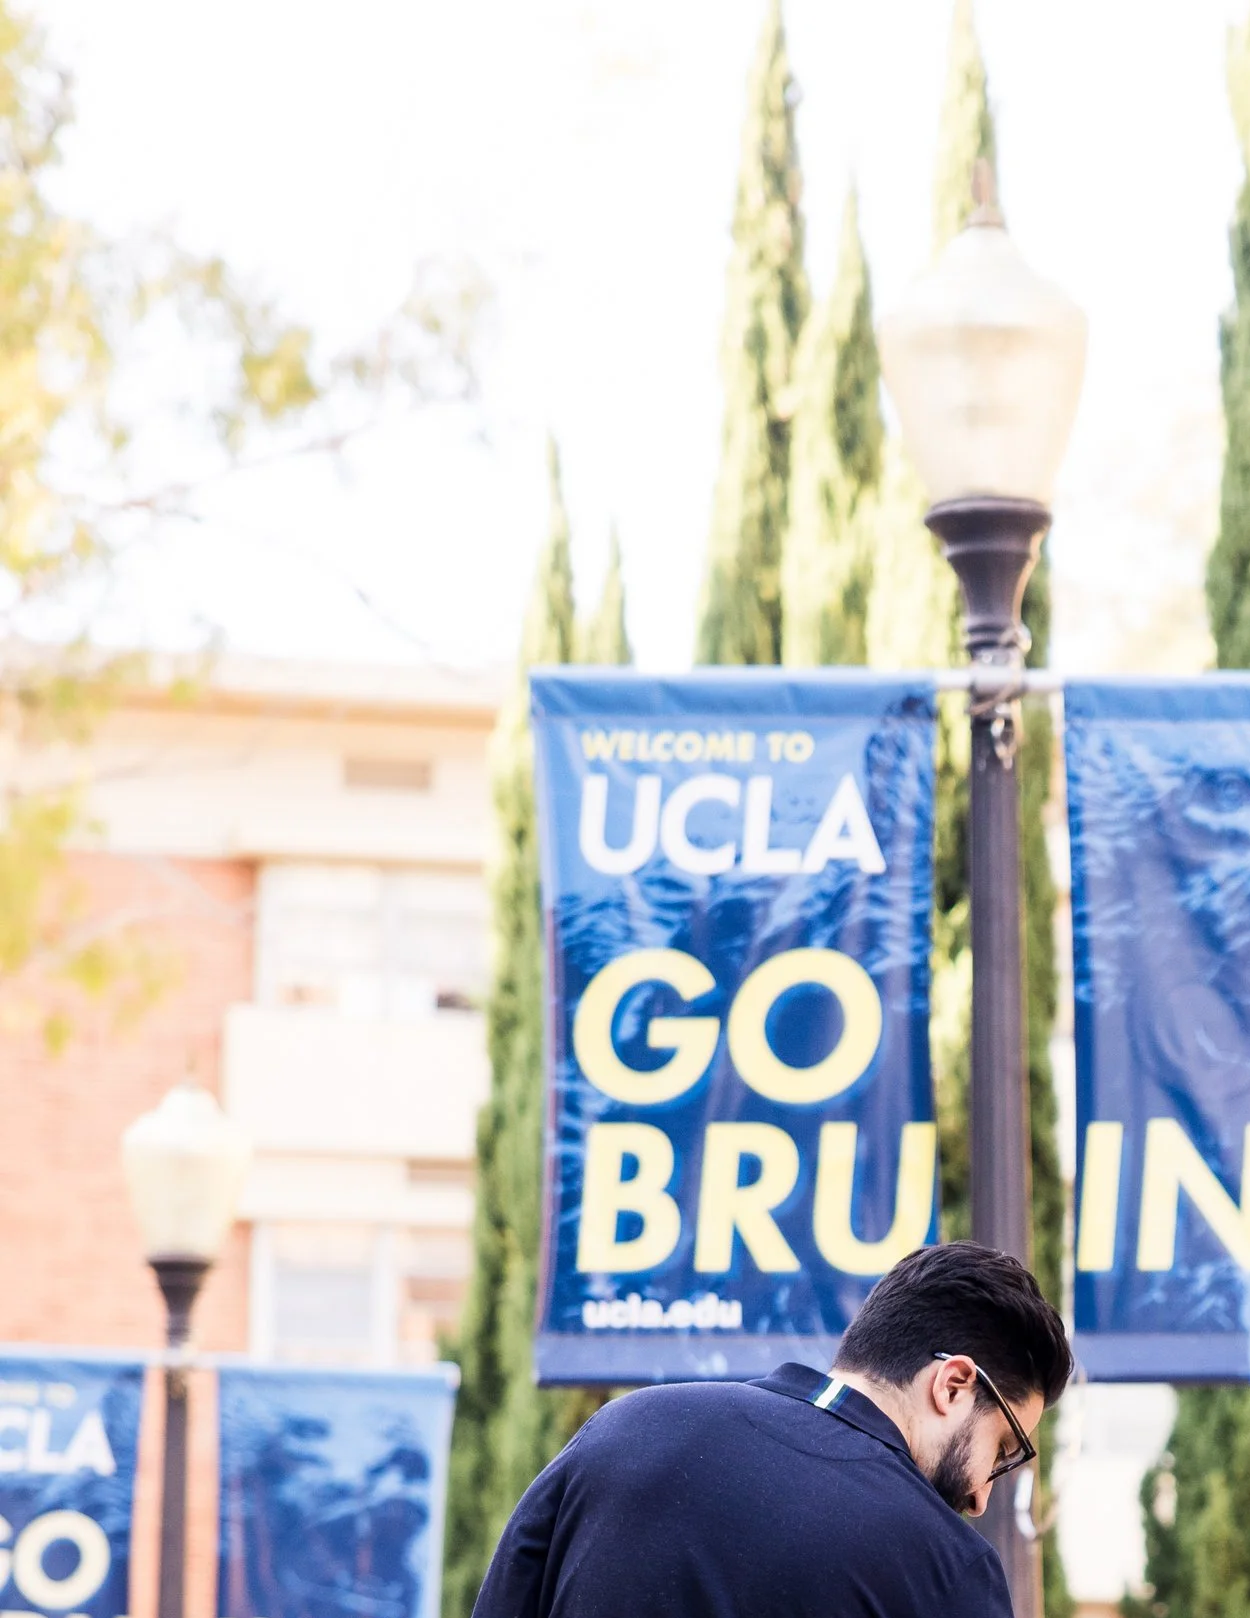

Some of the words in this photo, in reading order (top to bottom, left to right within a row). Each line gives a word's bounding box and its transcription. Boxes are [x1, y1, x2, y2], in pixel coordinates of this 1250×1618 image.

[581, 731, 756, 762] WELCOME
[767, 731, 814, 761] TO
[579, 773, 887, 875] UCLA
[573, 947, 883, 1105] GO
[576, 1122, 937, 1276] BRU
[582, 1292, 742, 1330] ucla.edu
[0, 1509, 111, 1611] O
